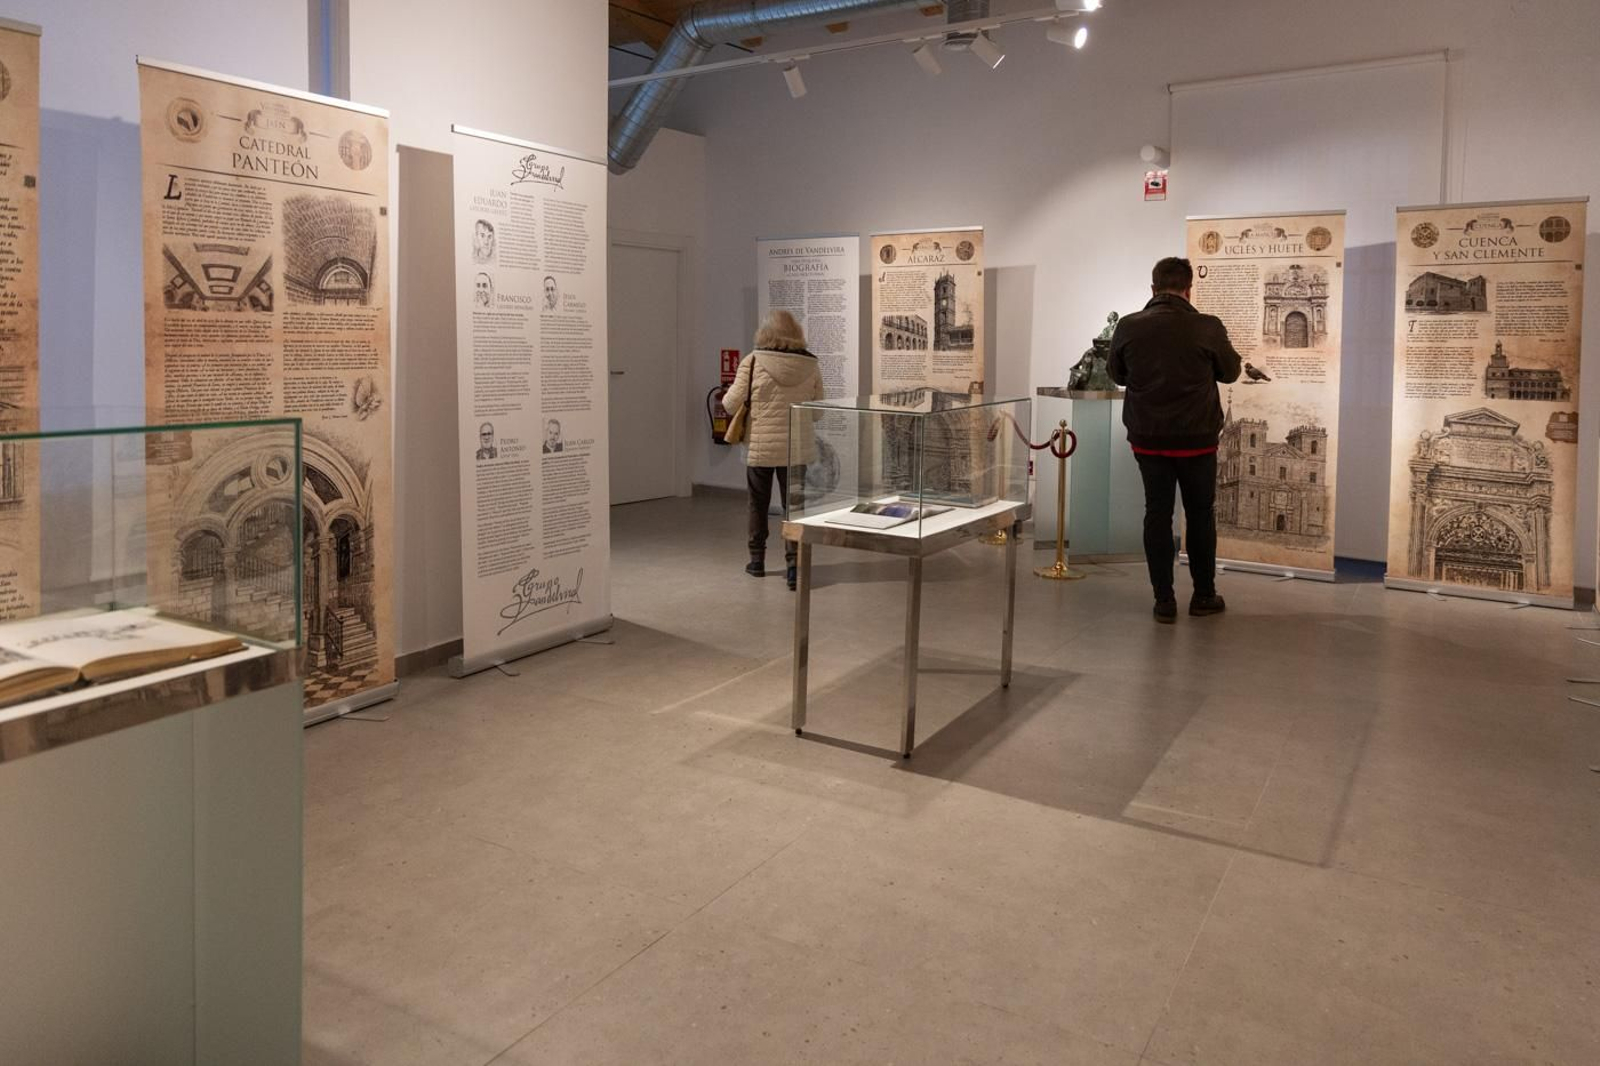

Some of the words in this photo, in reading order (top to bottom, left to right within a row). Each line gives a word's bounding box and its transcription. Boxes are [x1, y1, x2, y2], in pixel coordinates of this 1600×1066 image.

[239, 136, 311, 160] CATEDRAL
[232, 152, 318, 179] PANTEÓN
[1459, 236, 1518, 248] CUENCA
[1259, 246, 1266, 254] Y
[1269, 243, 1303, 254] HUETE
[1433, 251, 1441, 260] Y
[1445, 250, 1469, 260] SAN
[1474, 247, 1545, 259] CLEMENTE
[908, 254, 945, 264] ALCARAZ
[497, 293, 532, 304] FRANCISCO
